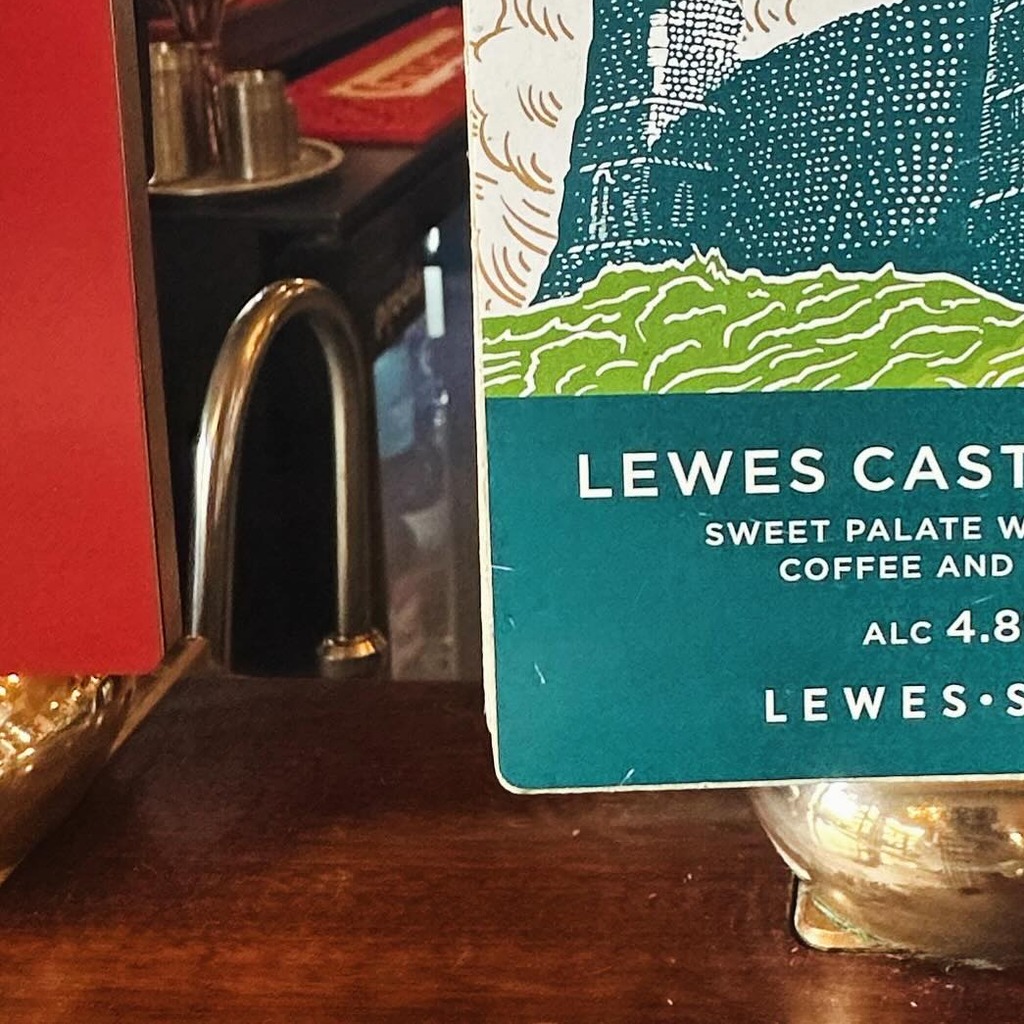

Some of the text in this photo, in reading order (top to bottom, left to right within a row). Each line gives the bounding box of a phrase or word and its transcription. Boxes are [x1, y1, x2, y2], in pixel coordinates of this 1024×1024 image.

[578, 448, 825, 499] LEWES
[705, 519, 831, 546] SWEET
[846, 516, 982, 543] PALATE
[779, 555, 922, 582] COFFEE
[936, 553, 1013, 578] AND
[862, 621, 932, 645] ALC
